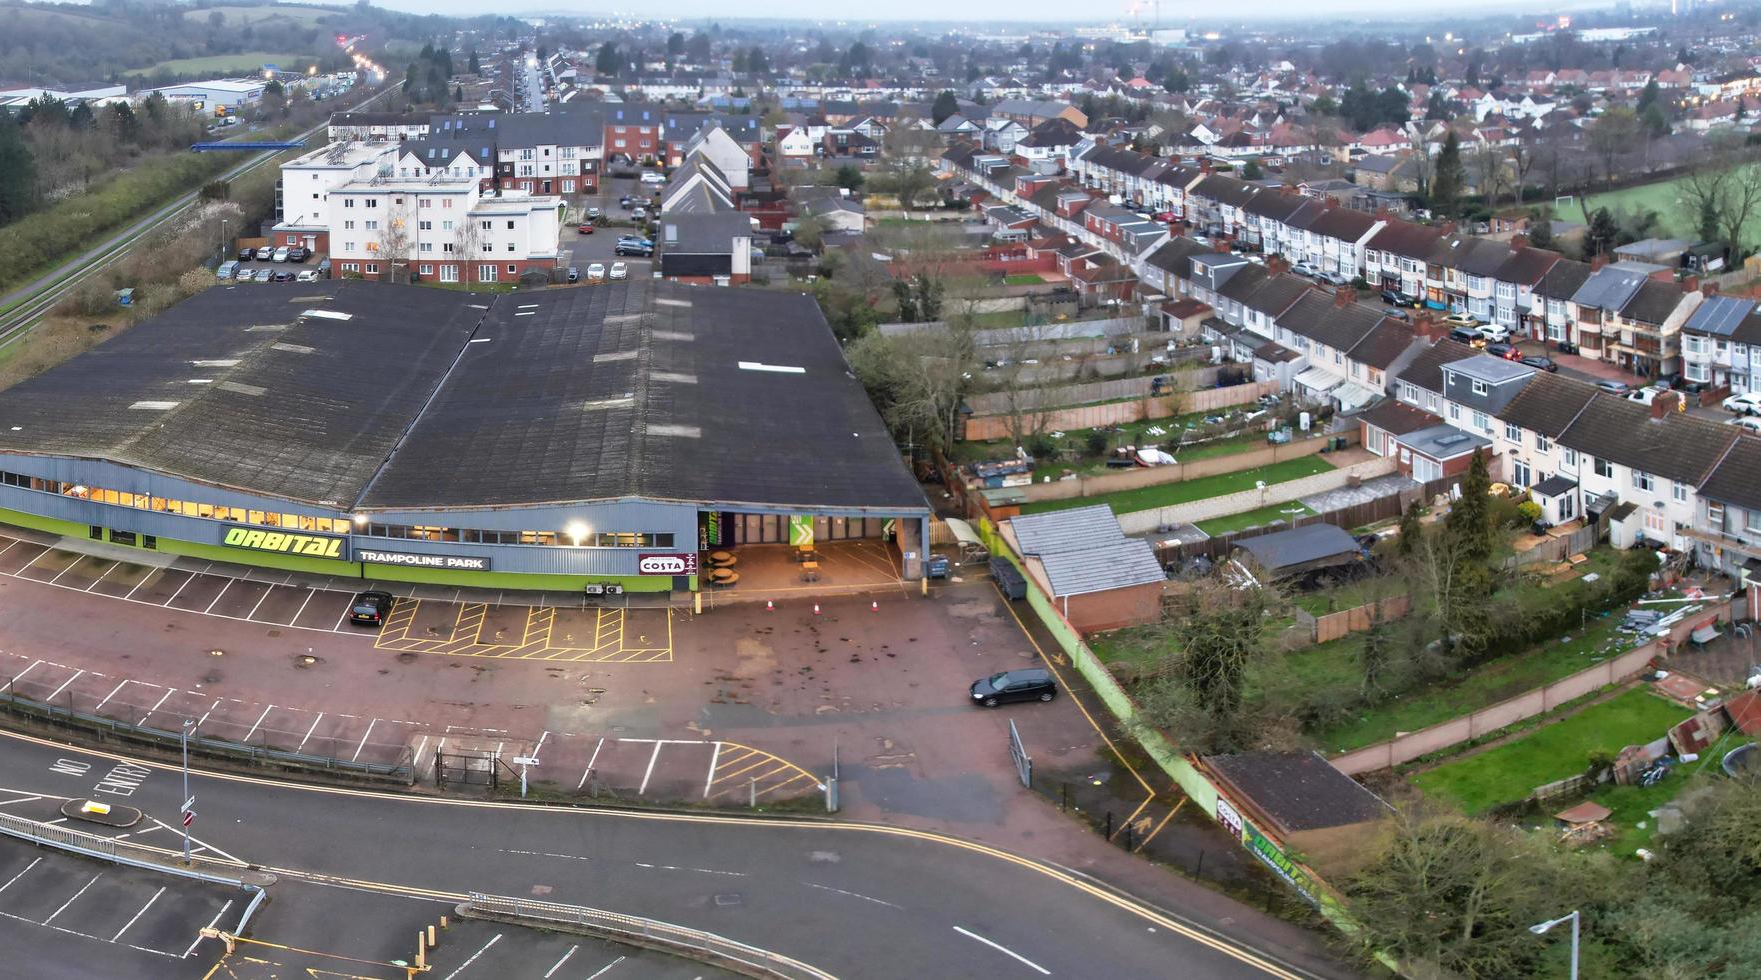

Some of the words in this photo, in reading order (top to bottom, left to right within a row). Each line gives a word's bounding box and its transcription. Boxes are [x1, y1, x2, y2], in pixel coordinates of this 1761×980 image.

[223, 527, 342, 558] ORBITAL
[360, 551, 443, 566] TRAMPOLINE
[447, 557, 483, 569] PARK
[643, 562, 681, 571] COSTA
[48, 758, 92, 777] NO
[93, 760, 152, 797] ENTRY
